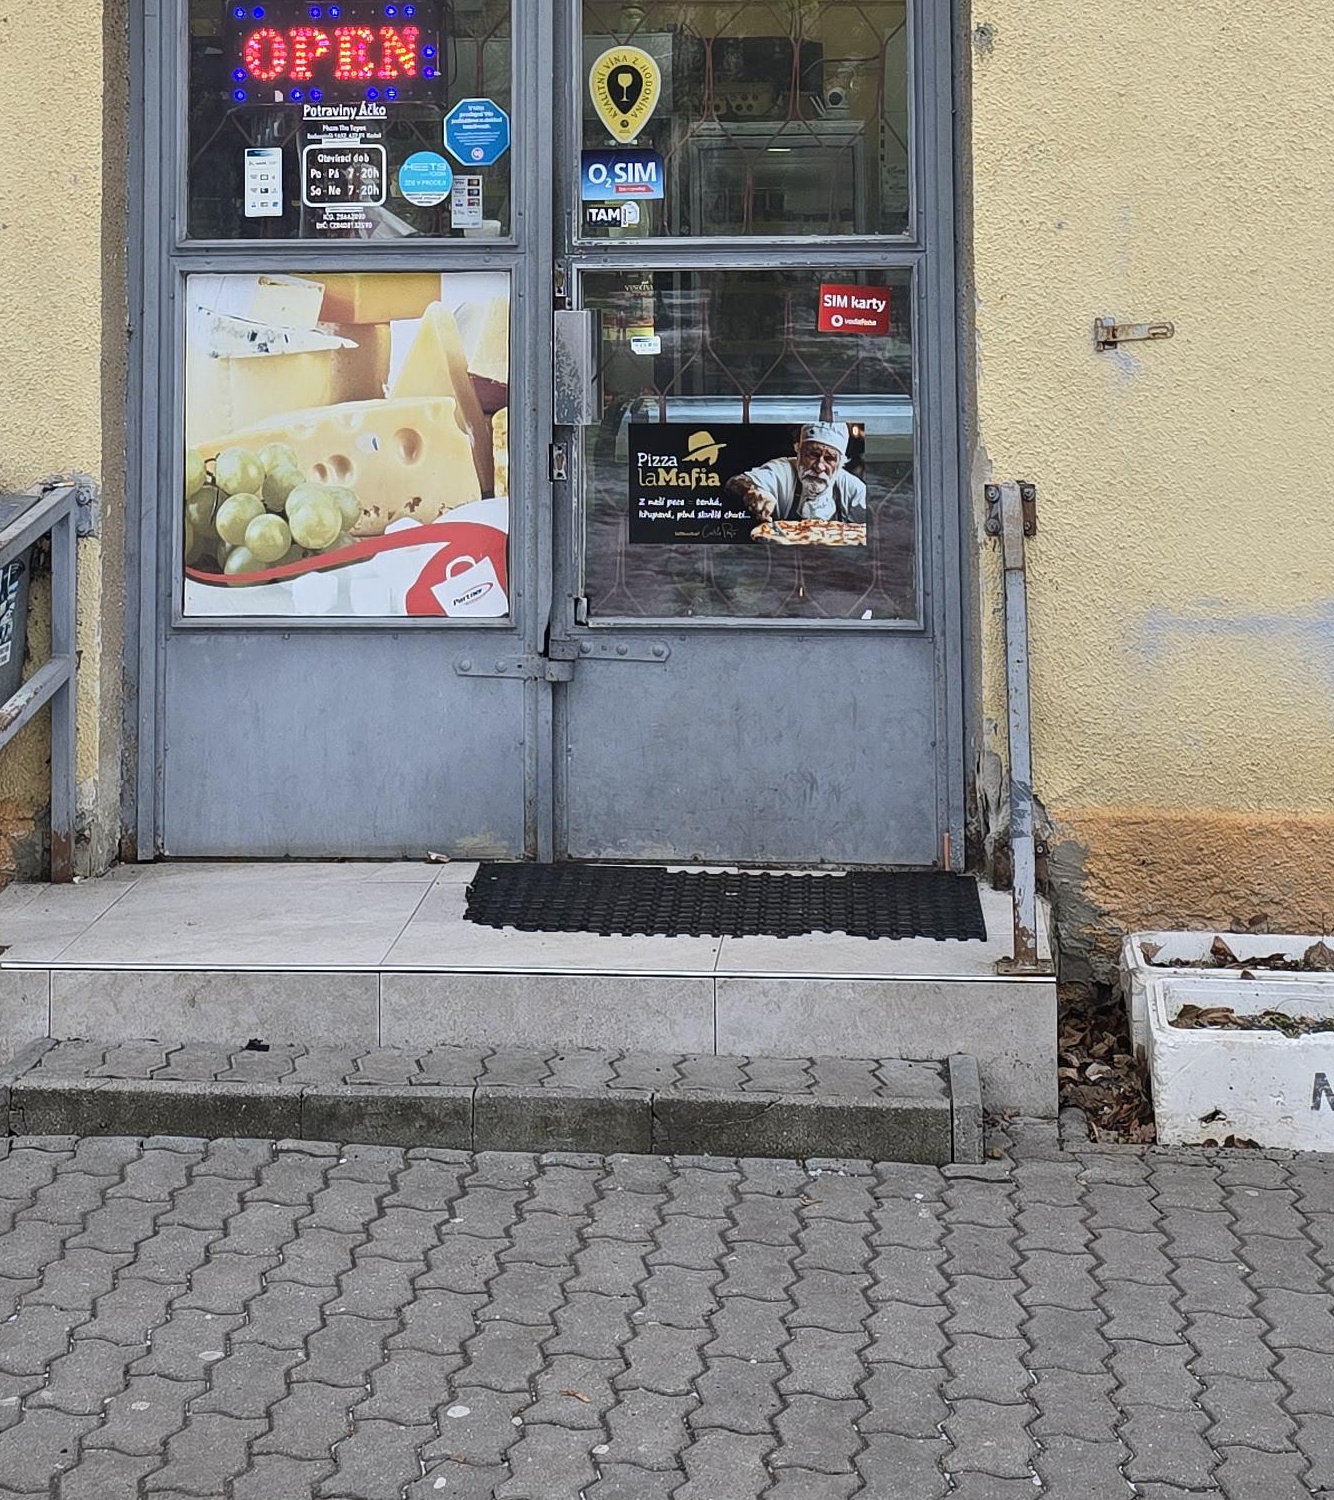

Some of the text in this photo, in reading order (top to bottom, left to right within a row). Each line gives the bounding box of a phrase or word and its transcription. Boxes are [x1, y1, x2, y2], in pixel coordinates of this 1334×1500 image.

[243, 25, 420, 82] OPEN
[303, 103, 357, 120] Potraviny
[310, 168, 322, 179] Po
[328, 167, 340, 179] Pá
[347, 168, 354, 179] 7
[361, 167, 380, 179] 20h
[614, 161, 657, 183] SIM
[310, 185, 322, 196] So
[328, 185, 341, 196] Ne
[348, 185, 354, 195] 7
[361, 184, 380, 196] 20h
[823, 294, 886, 313] SIM karty
[637, 452, 678, 467] Pizza
